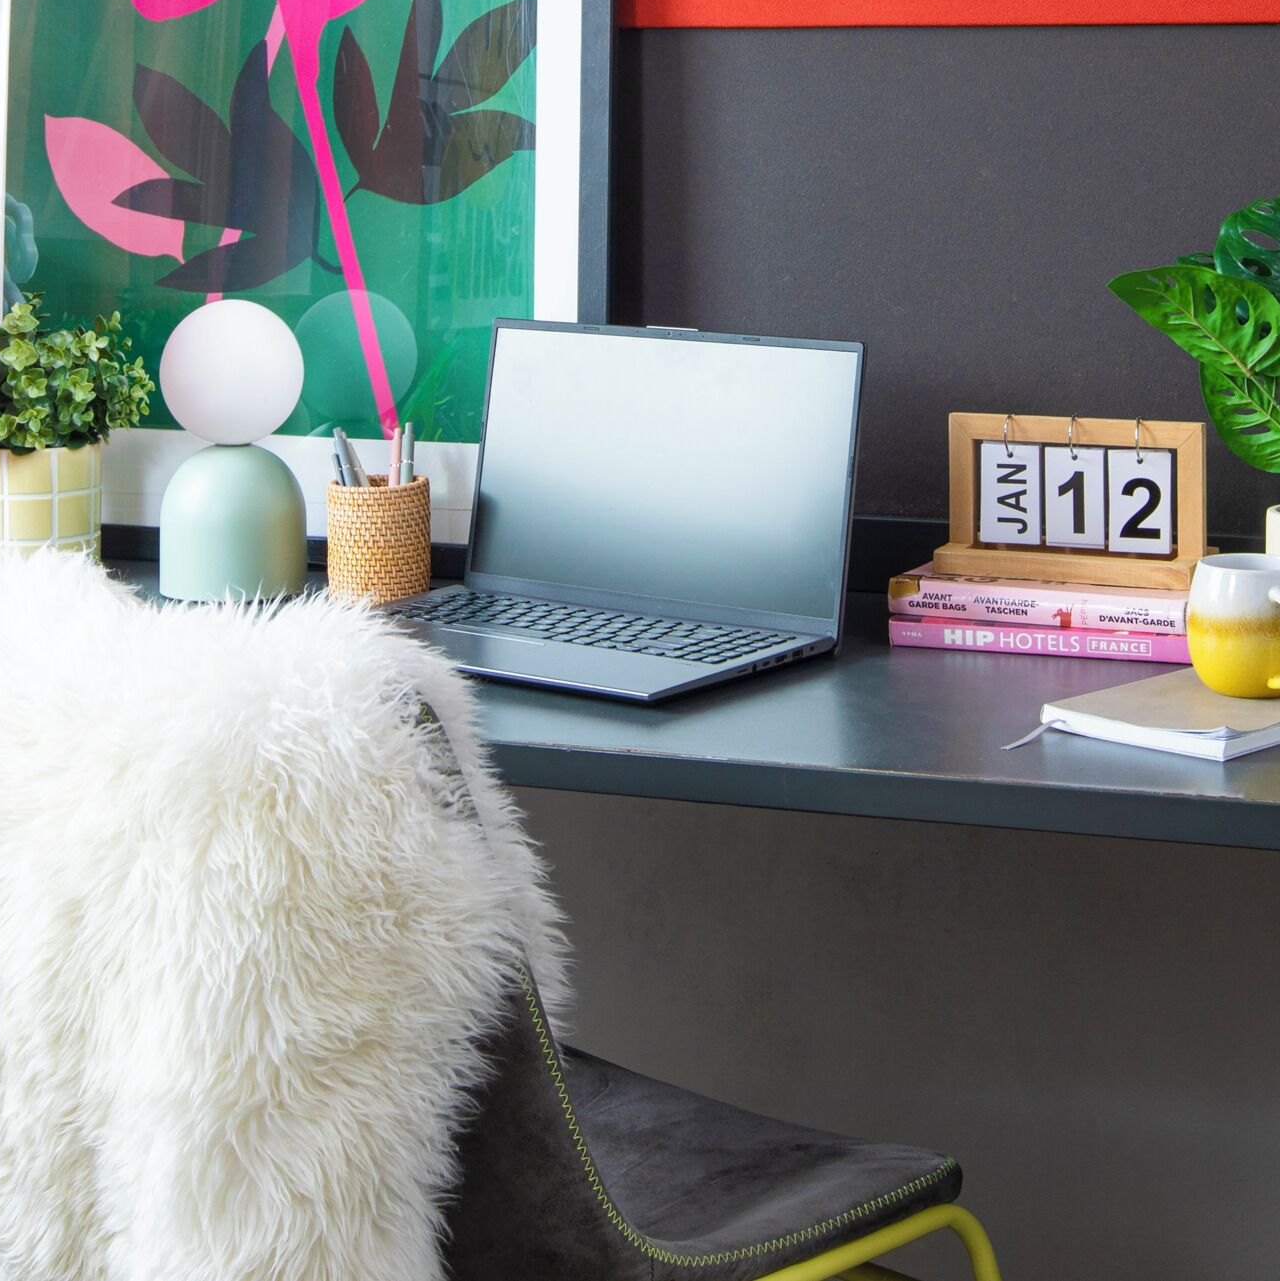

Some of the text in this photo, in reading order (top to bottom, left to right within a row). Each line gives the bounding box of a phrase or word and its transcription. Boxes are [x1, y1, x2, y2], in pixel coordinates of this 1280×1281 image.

[996, 463, 1028, 535] JAN
[921, 592, 953, 603] AVANT
[973, 595, 1040, 609] AVANTGARDE-
[908, 600, 967, 613] GARDE BAGS
[985, 606, 1028, 617] TASCHEN
[1099, 615, 1176, 628] D'AVANT-GARDE
[943, 628, 1148, 653] HIP HOTELS FRANCE
